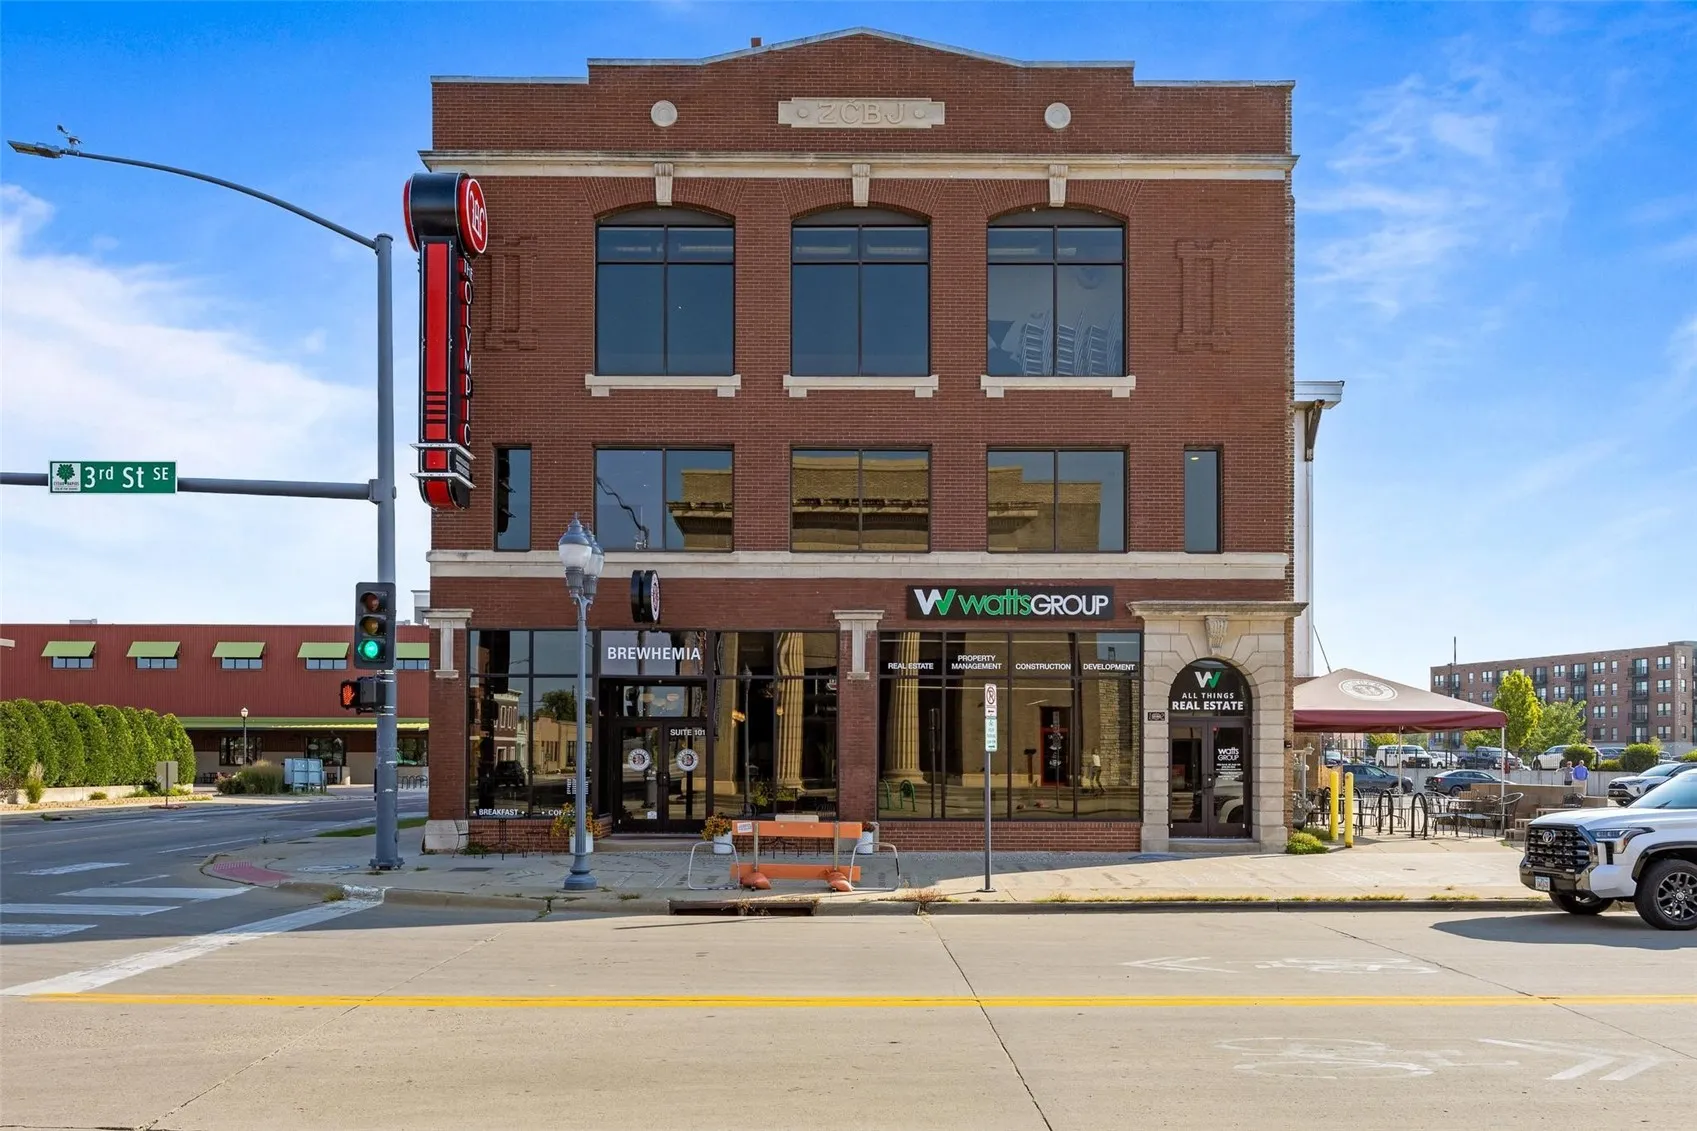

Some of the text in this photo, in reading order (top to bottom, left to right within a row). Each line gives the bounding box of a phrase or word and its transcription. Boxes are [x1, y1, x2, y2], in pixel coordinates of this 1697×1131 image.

[463, 280, 473, 446] OLYMPIC
[84, 466, 169, 489] 3rd St SE
[607, 646, 701, 660] BREWHEMIA
[957, 654, 996, 662] PROPERTY
[887, 662, 934, 670] REAL ESTATE
[951, 663, 1003, 671] MANAGEMENT
[1015, 663, 1072, 671] CONSTRUCTION
[1083, 663, 1136, 671] DEVELOPMENT
[1172, 701, 1244, 710] REAL ESTATE
[669, 728, 706, 736] SUITE 101
[478, 808, 519, 816] BREAKFAST
